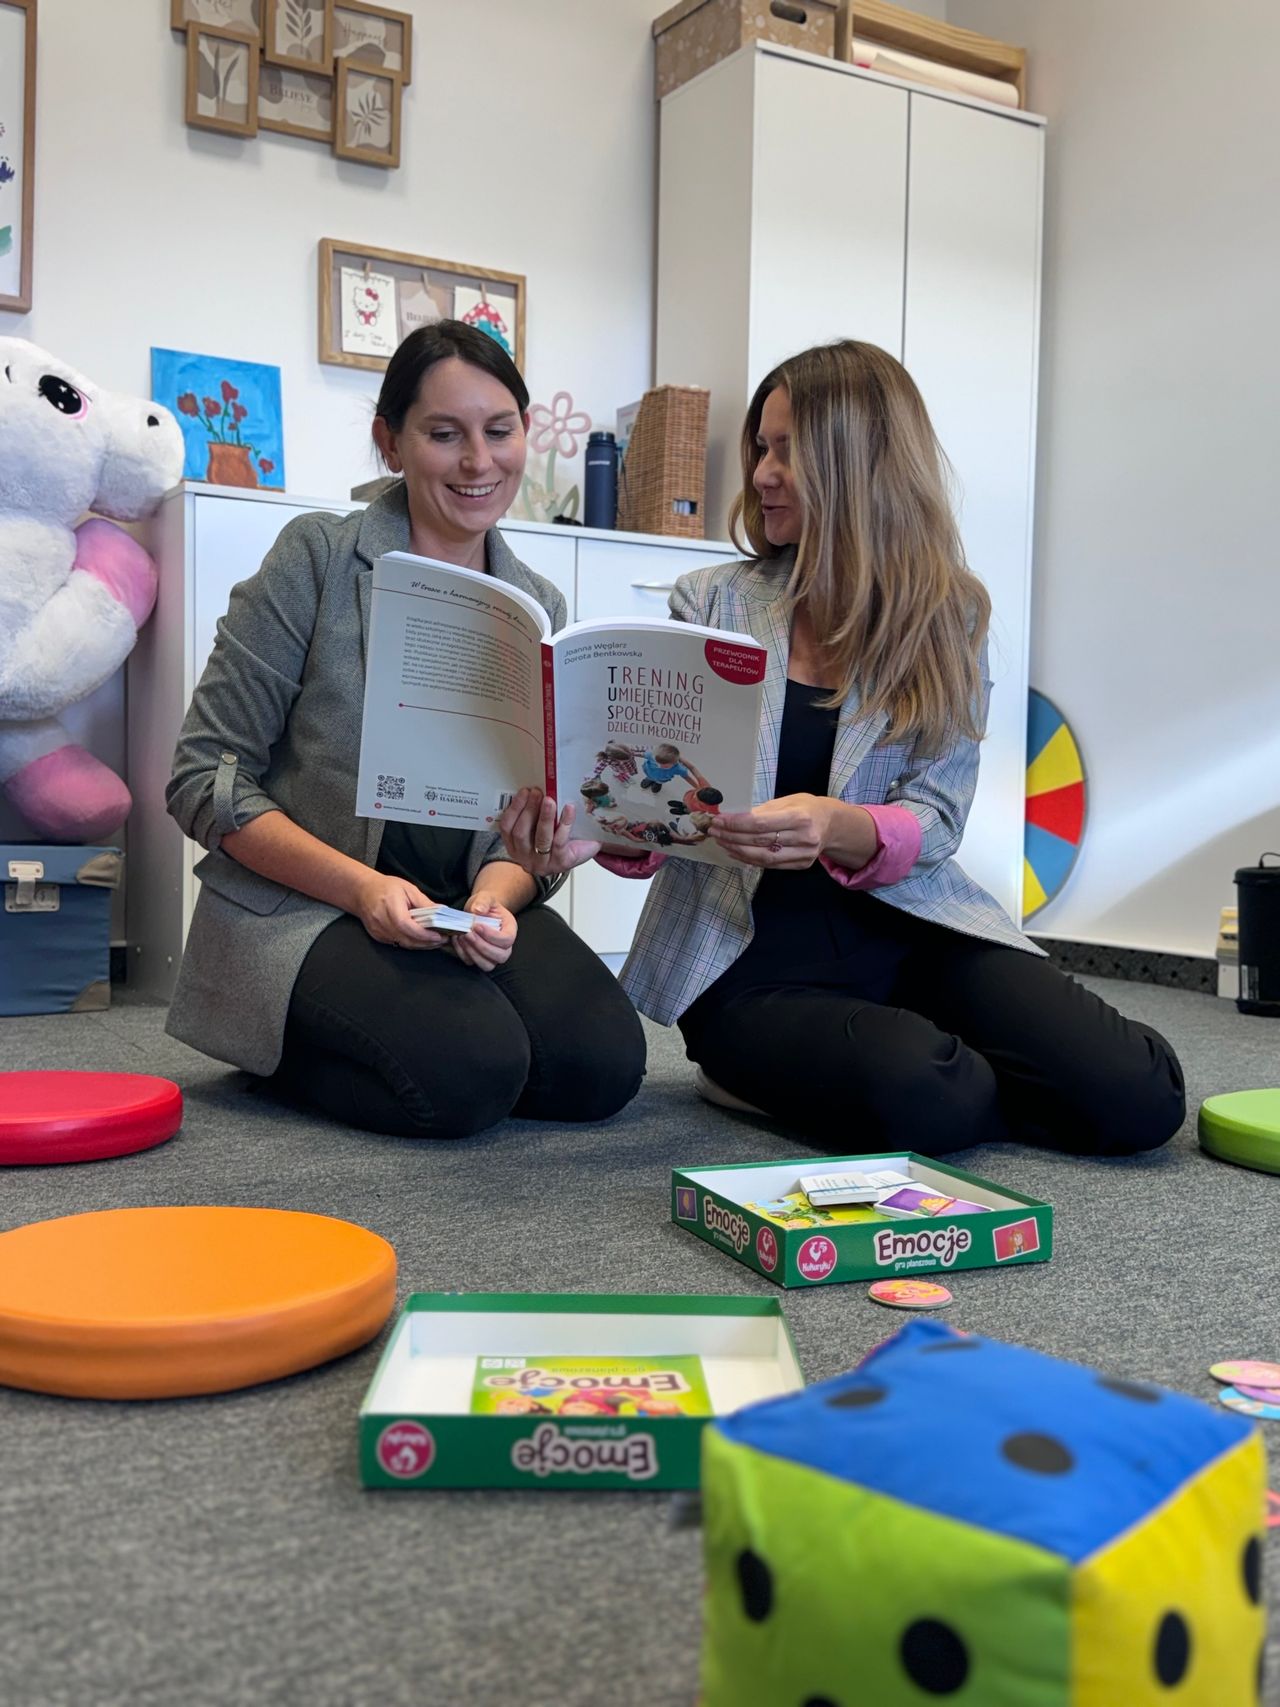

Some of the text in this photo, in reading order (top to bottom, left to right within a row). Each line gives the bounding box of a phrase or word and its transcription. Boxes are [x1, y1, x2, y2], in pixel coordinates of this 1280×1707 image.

[563, 641, 627, 658] Joanna Węglarz
[564, 649, 643, 665] Dorota Bentkowska
[713, 646, 760, 662] PRZEWODNIK
[712, 660, 760, 675] TERAPEUTÓW
[728, 657, 743, 666] DLA
[607, 666, 704, 694] TRENING
[607, 686, 703, 713] UMIEJĘTNOŚCI
[607, 705, 702, 732] SPOŁECZNYCH
[607, 721, 639, 734] DZIECI
[641, 723, 645, 734] I
[705, 1198, 749, 1249] Emocje
[878, 1226, 970, 1262] Emocje
[489, 1369, 682, 1392] Emocje
[517, 1427, 651, 1475] Emocje
